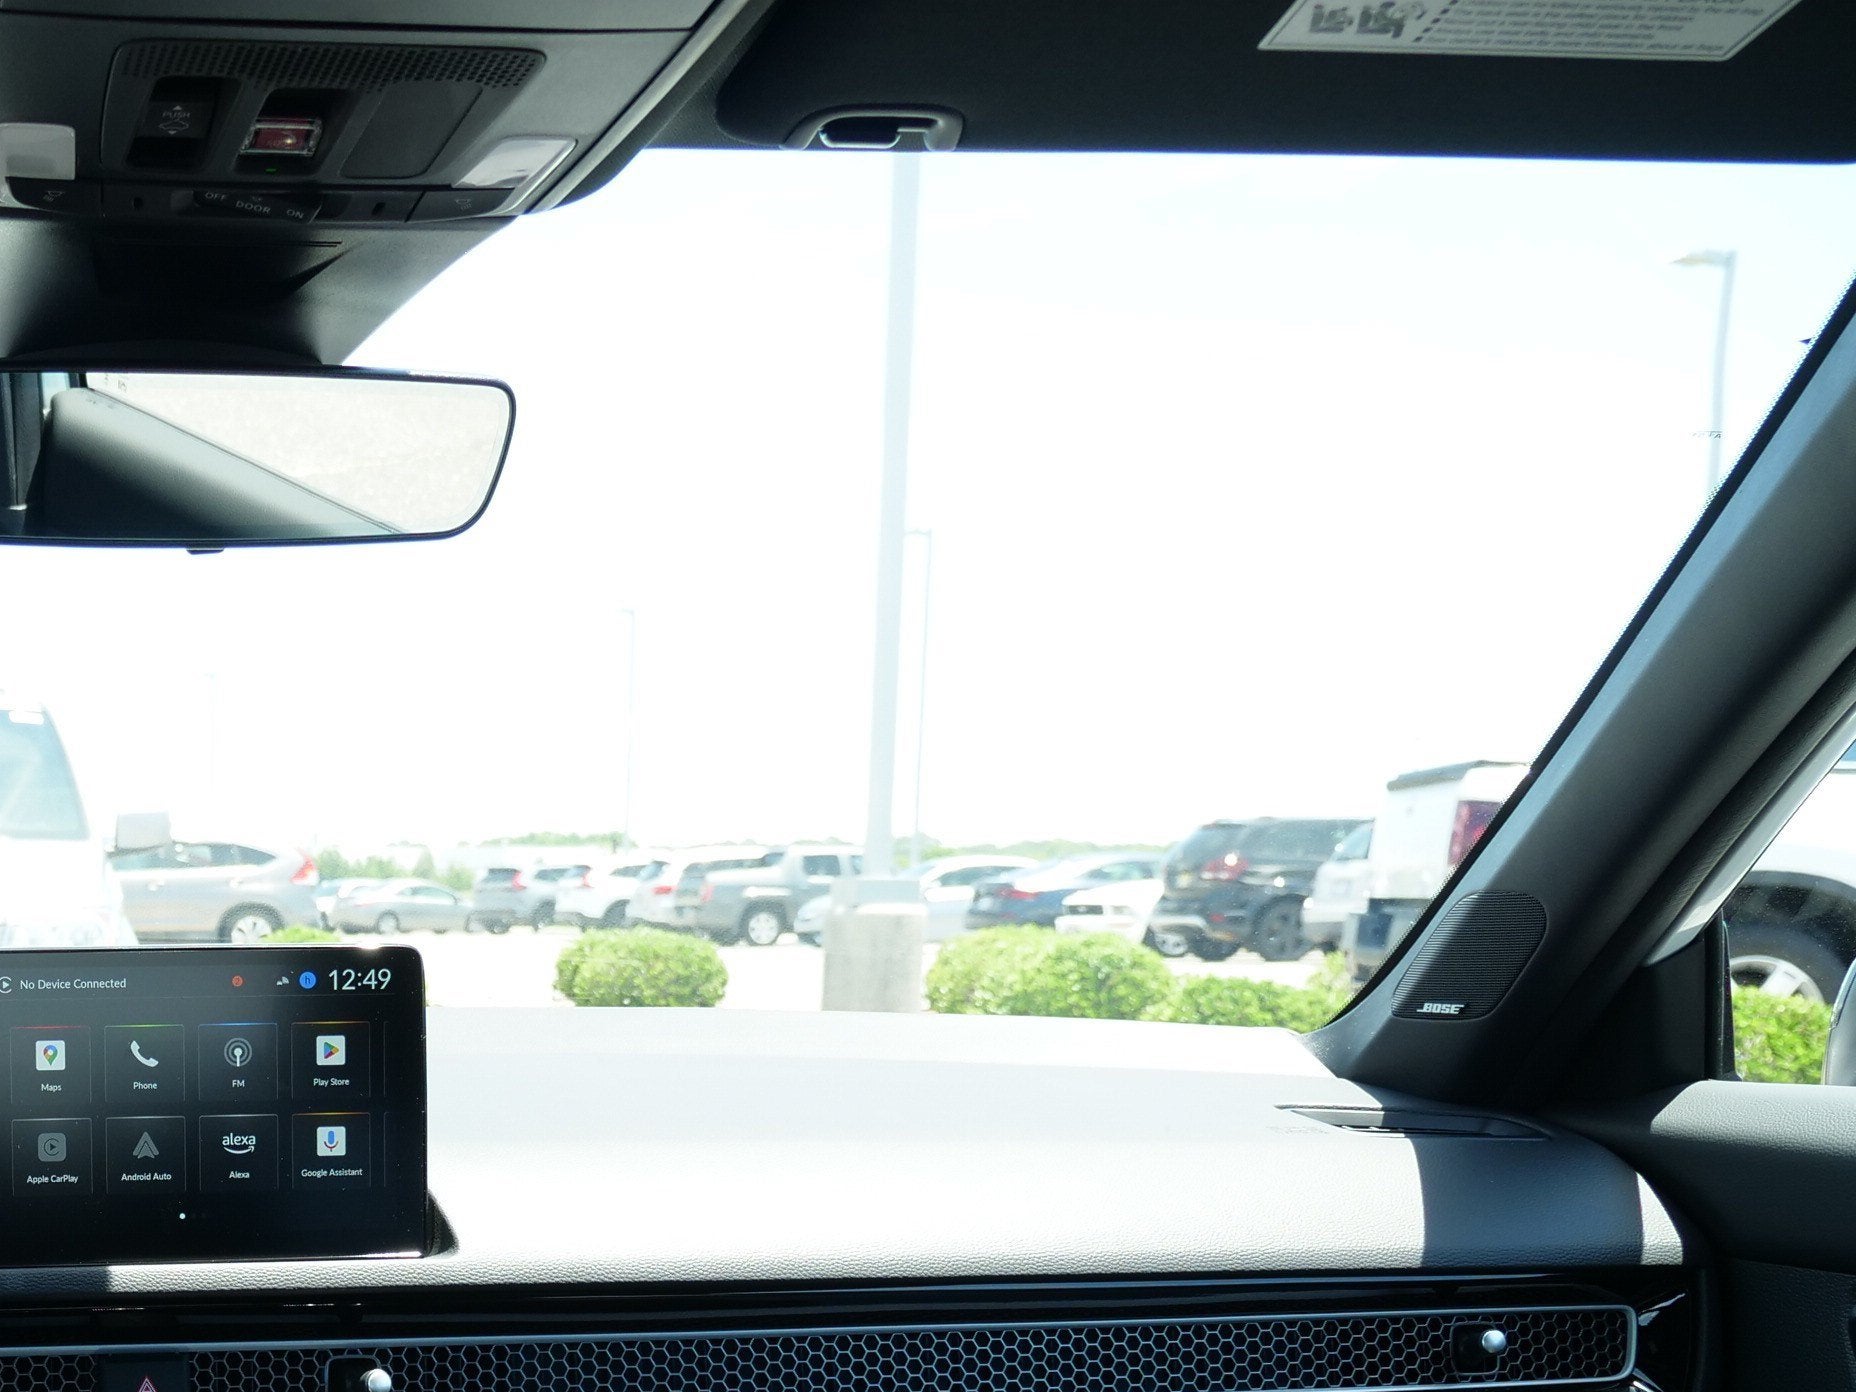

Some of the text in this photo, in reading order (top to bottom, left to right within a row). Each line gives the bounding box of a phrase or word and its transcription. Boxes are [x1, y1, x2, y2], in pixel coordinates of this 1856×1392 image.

[162, 111, 191, 119] PUSH
[205, 191, 305, 219] OFF DOOR ON
[20, 978, 127, 990] No Device Connected
[328, 968, 392, 991] 12:49
[1416, 1002, 1465, 1015] BOSE
[133, 1081, 157, 1091] Phone
[232, 1080, 245, 1088] FM
[313, 1077, 350, 1087] Play Store
[41, 1083, 62, 1092] Maps
[222, 1133, 256, 1146] alexa
[121, 1171, 172, 1182] Android Auto
[229, 1171, 250, 1179] Alexa
[301, 1168, 363, 1178] Google Assistant
[27, 1174, 78, 1184] Apple CarPlay
